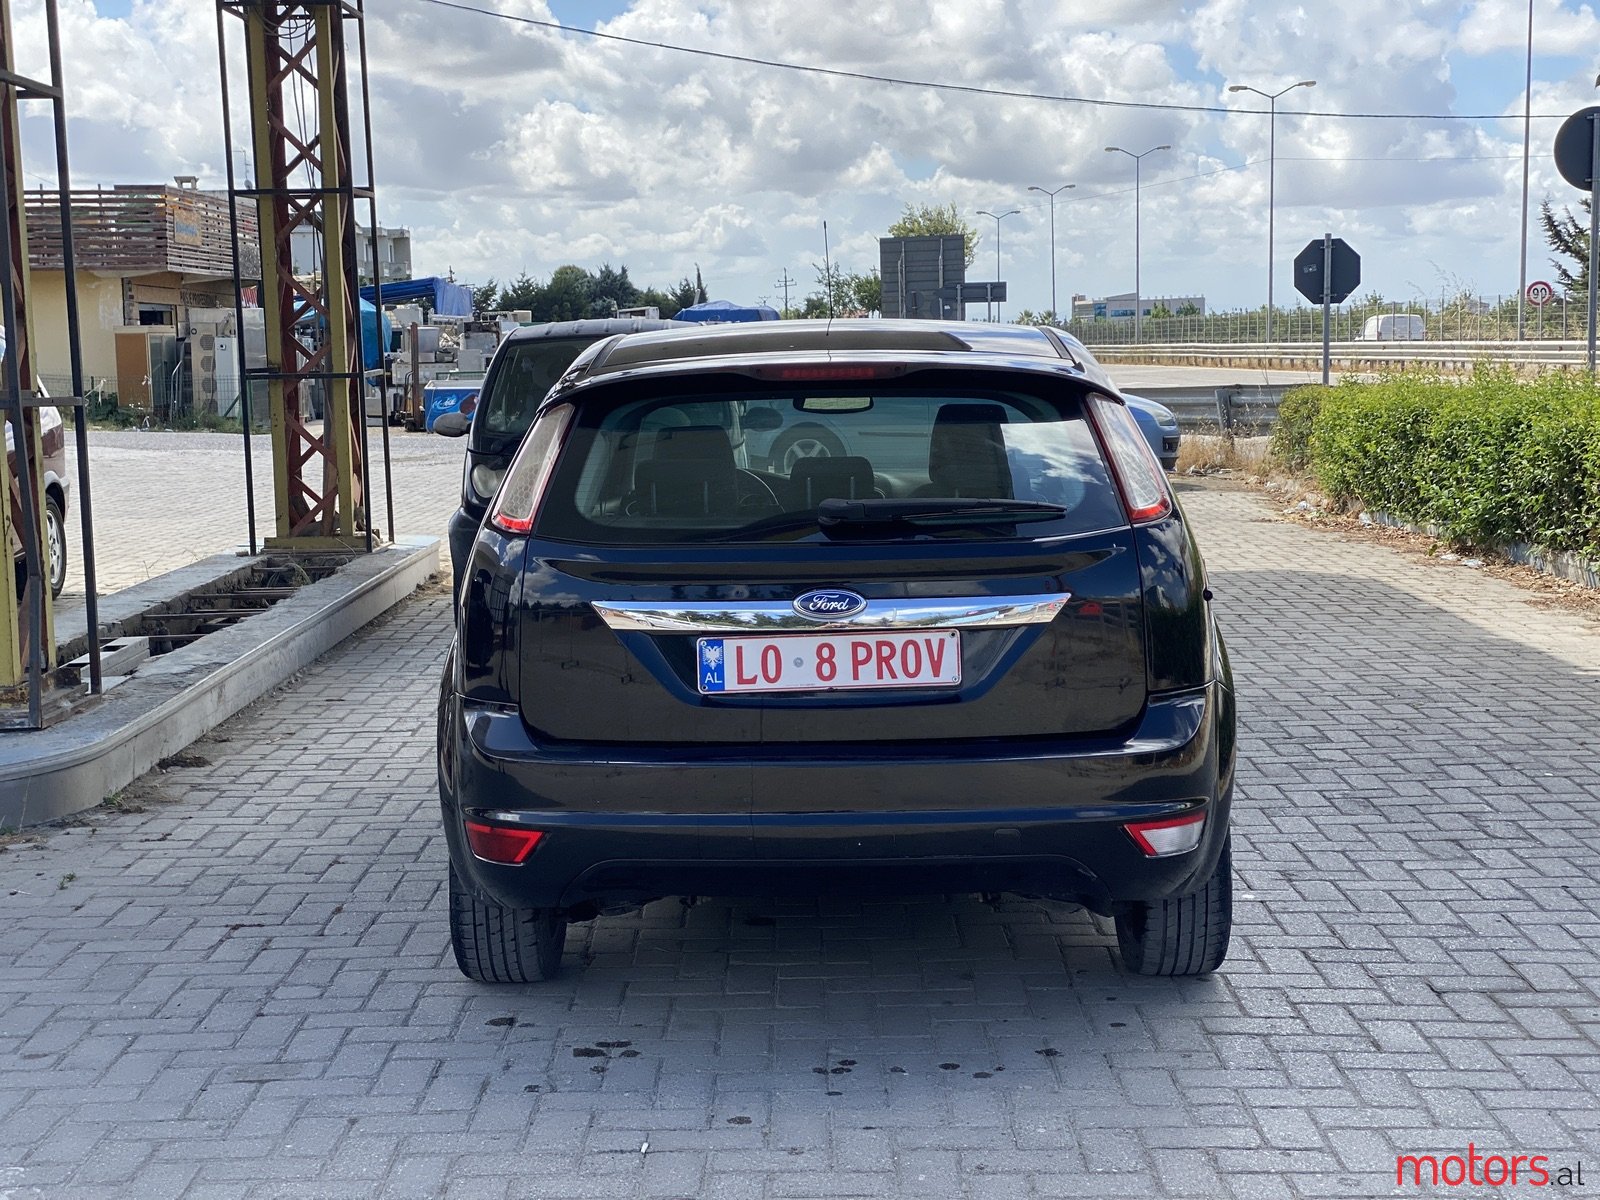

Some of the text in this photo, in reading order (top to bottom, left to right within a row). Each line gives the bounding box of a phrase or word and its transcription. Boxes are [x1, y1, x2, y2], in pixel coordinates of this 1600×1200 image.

[1532, 287, 1547, 299] 90
[809, 594, 850, 611] Ford
[815, 642, 837, 682] 8
[851, 637, 946, 681] PROV
[704, 672, 723, 684] AL
